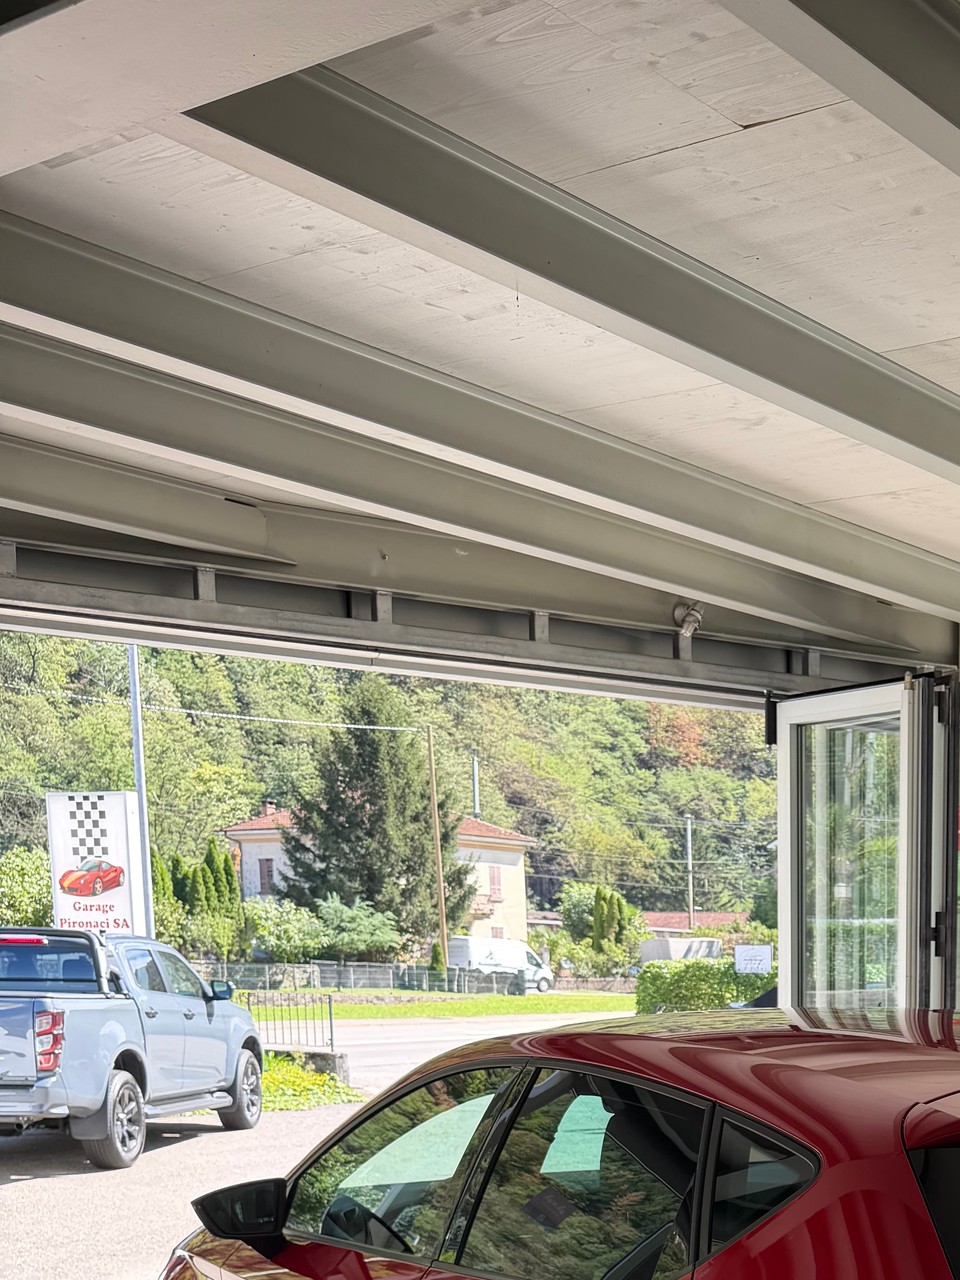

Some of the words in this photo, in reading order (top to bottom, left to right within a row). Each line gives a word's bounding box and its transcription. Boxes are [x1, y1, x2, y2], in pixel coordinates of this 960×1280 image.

[73, 901, 115, 914] Garage
[59, 917, 110, 929] Pironaci
[112, 917, 130, 929] SA
